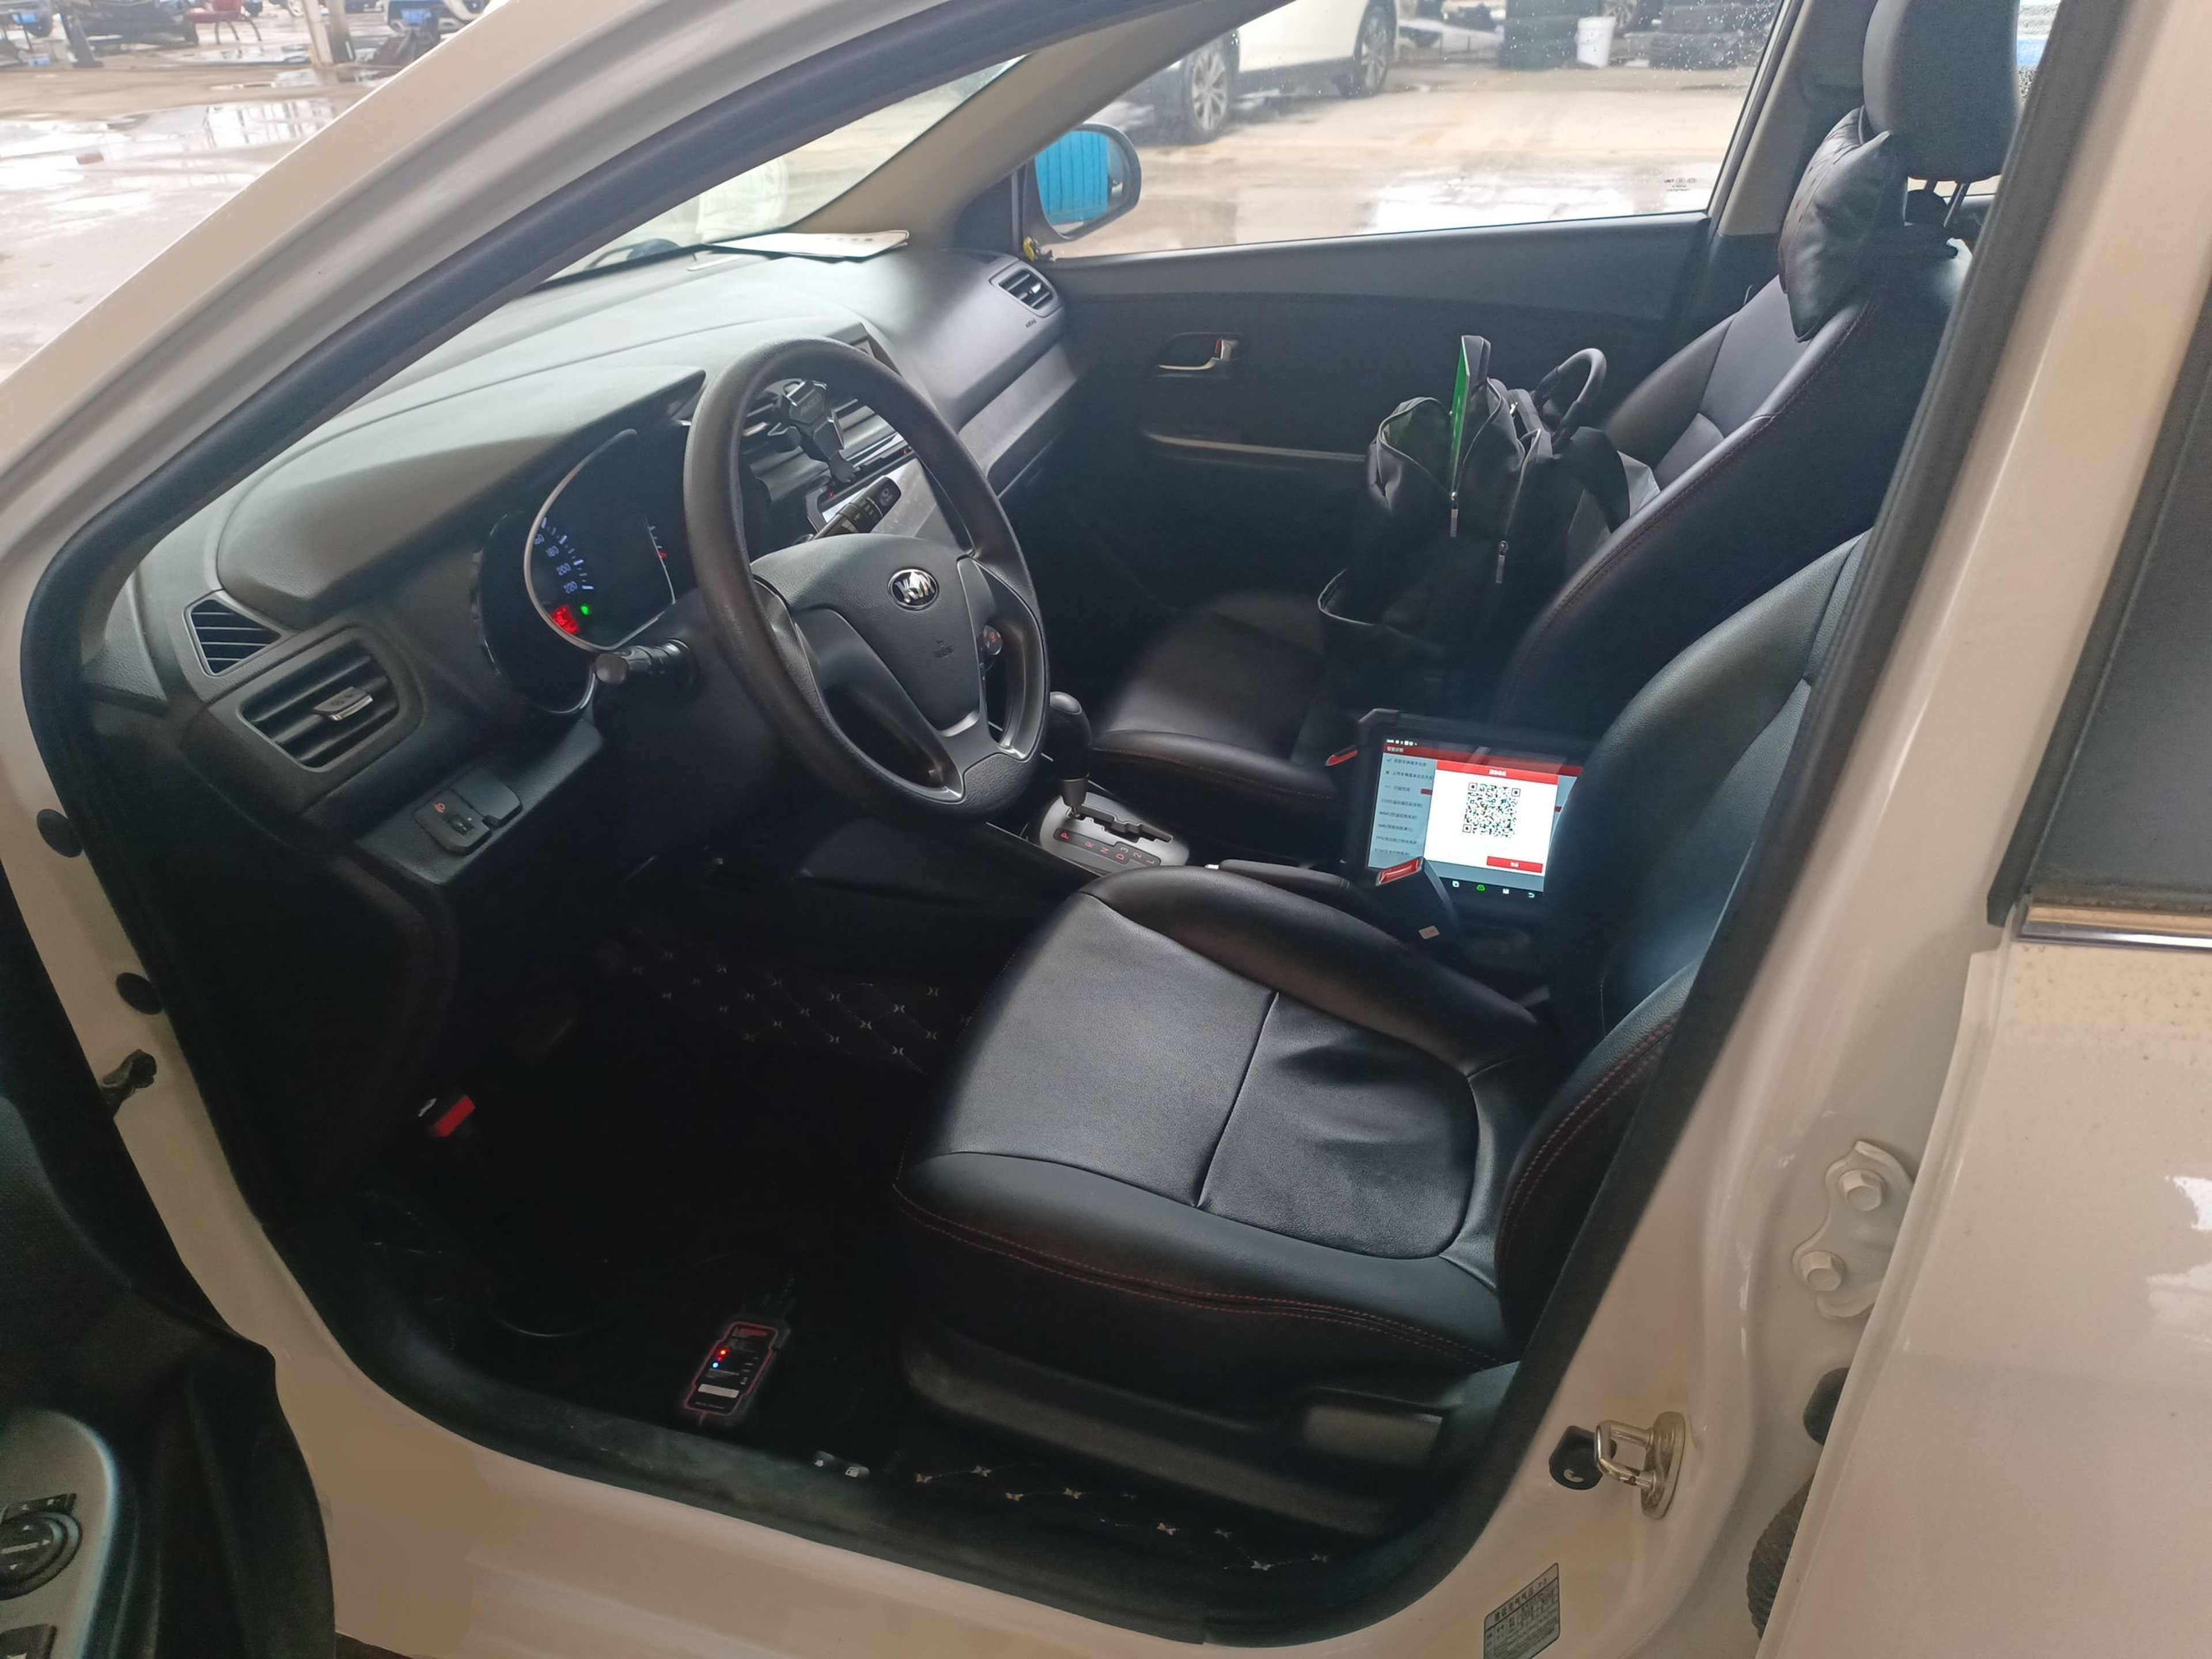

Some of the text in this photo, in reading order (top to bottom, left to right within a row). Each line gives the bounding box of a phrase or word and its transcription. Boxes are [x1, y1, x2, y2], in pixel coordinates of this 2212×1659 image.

[546, 546, 559, 557] 180
[557, 563, 571, 575] 200
[563, 581, 577, 593] 220
